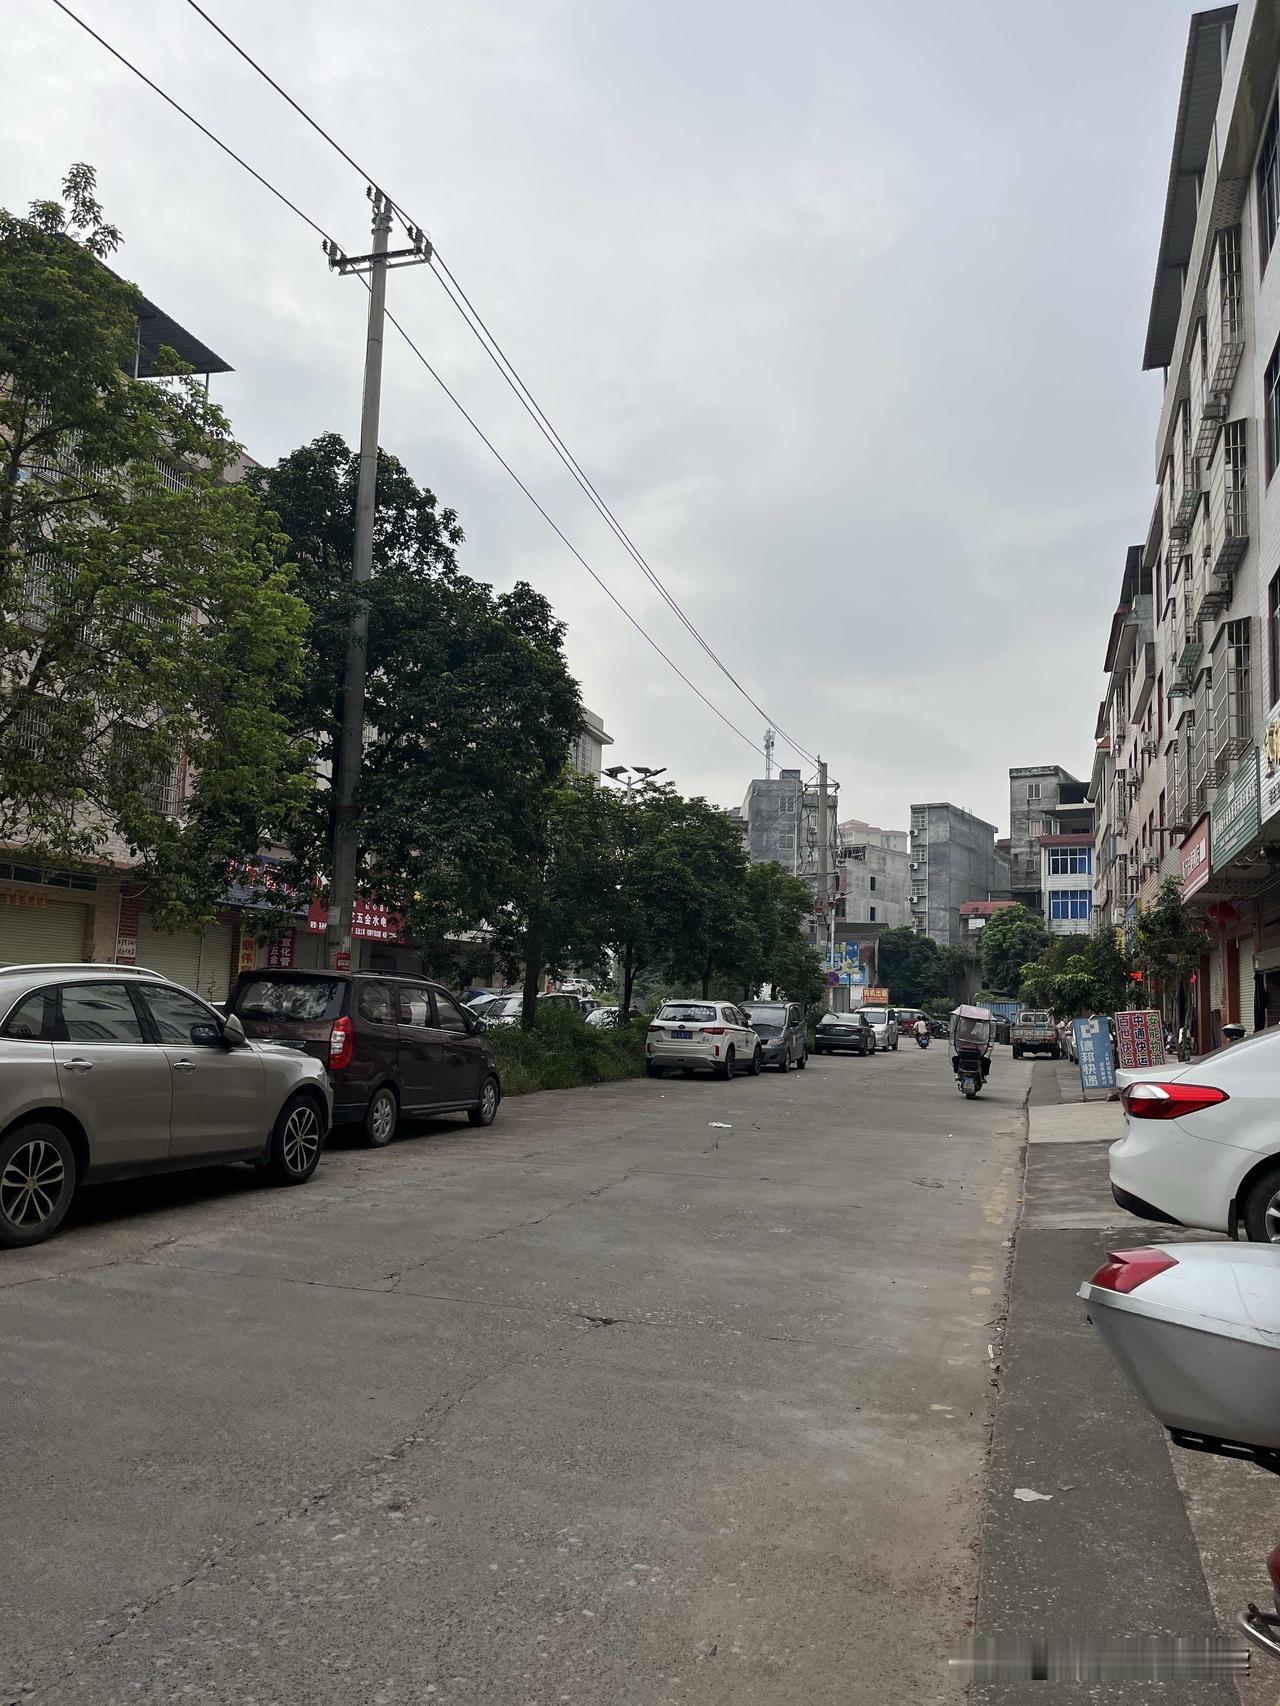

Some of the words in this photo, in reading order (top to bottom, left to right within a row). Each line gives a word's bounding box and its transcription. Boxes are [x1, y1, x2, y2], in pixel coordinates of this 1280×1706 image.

[352, 912, 387, 928] 五金水电
[1118, 1015, 1135, 1067] 百世快运
[1132, 1014, 1149, 1066] 中通快运
[1147, 1013, 1163, 1066] 安能物流
